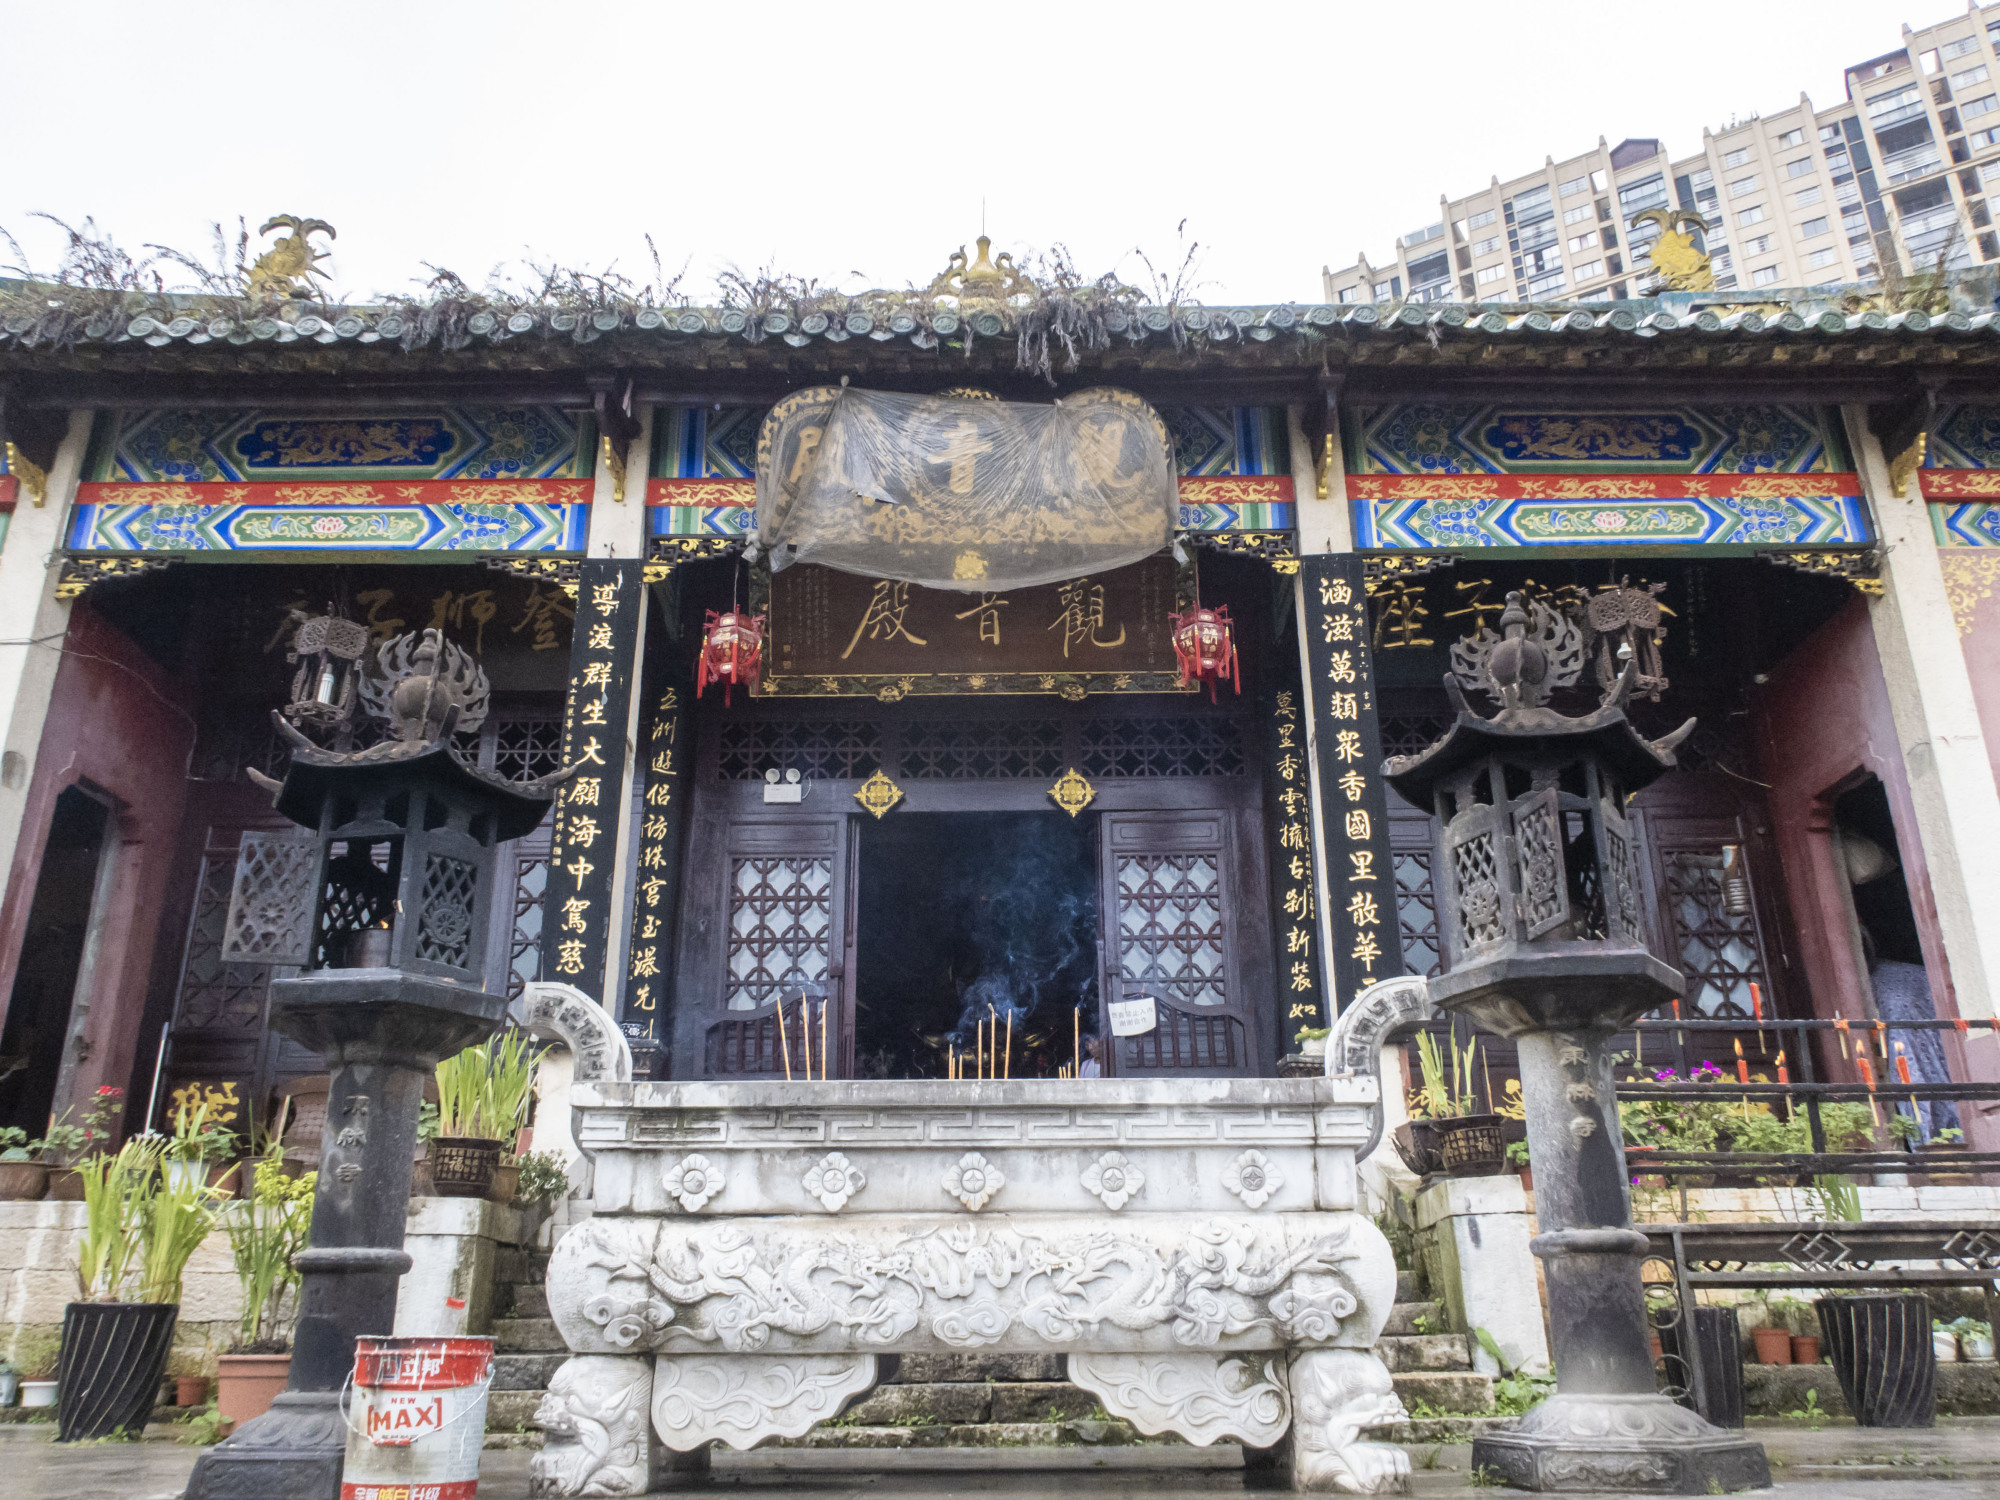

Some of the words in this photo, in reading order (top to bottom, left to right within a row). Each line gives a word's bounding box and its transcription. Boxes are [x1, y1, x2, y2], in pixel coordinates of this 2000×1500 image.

[841, 578, 1126, 658] 觀音殿
[555, 583, 620, 988] 導渡群生大願海中駕慈
[448, 1156, 464, 1173] 福
[402, 1358, 441, 1377] 立邦
